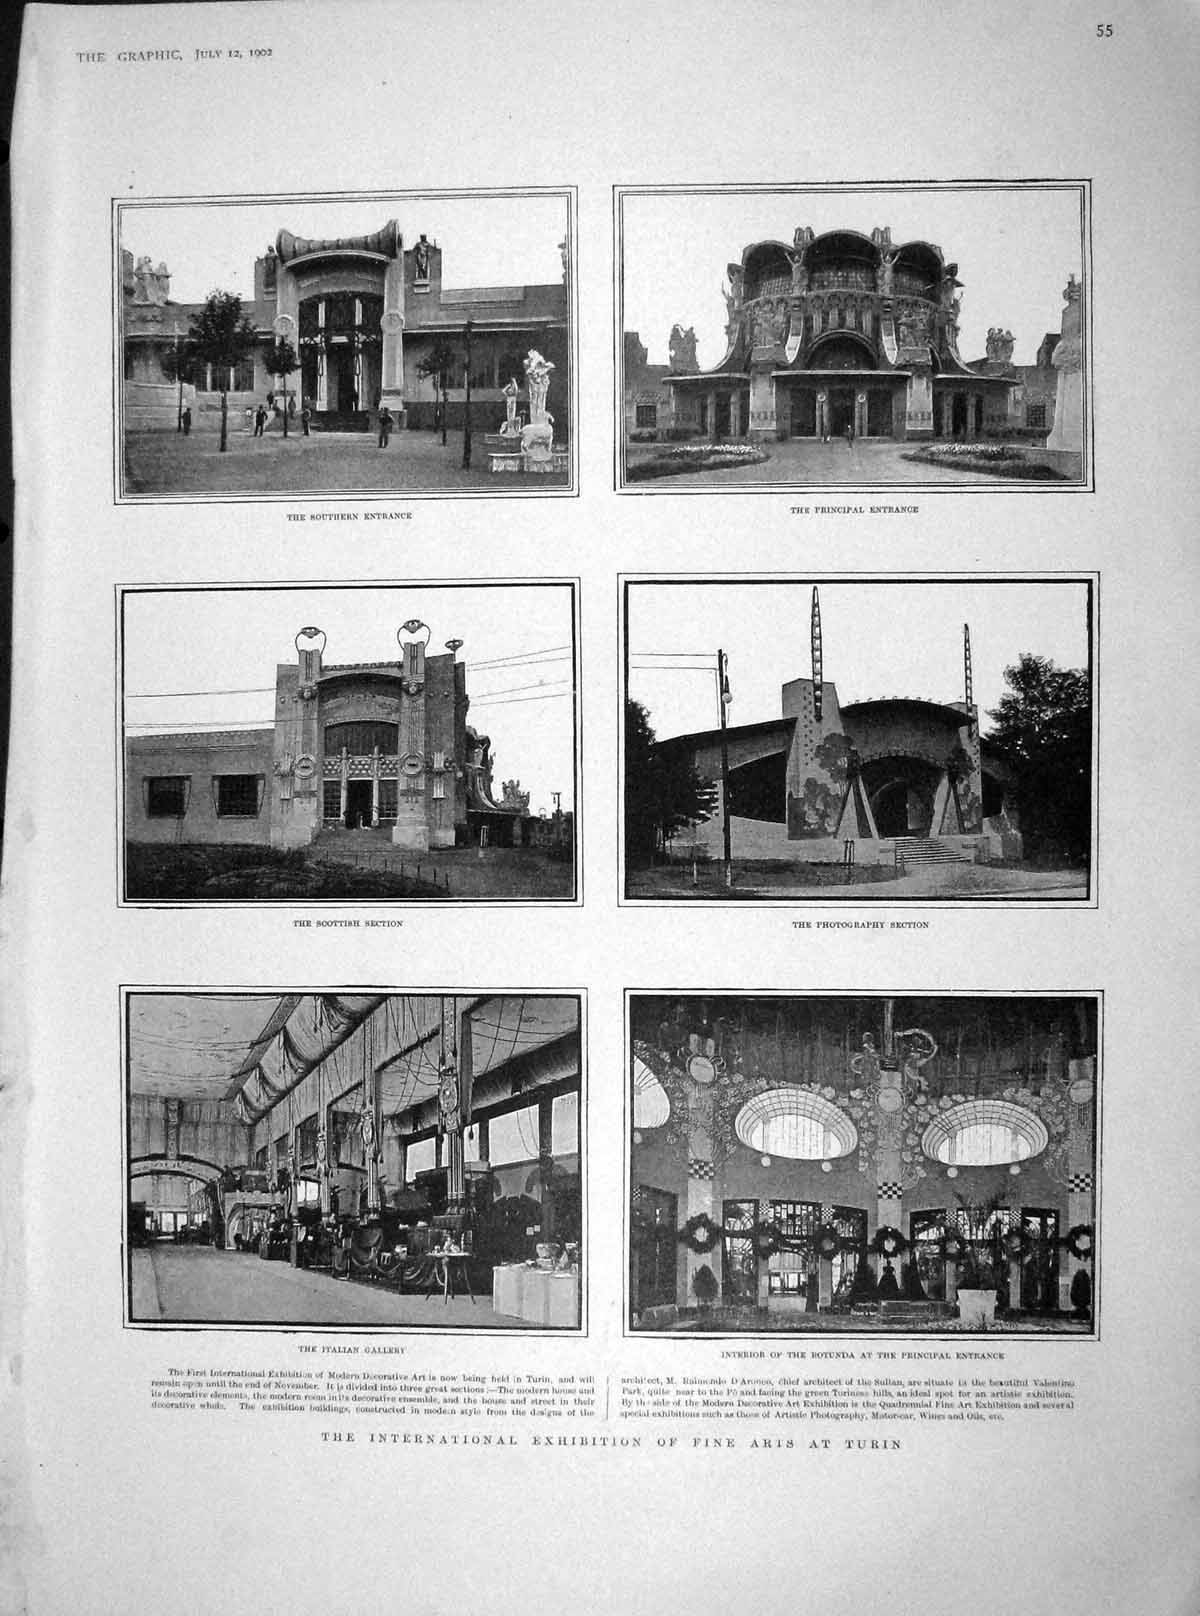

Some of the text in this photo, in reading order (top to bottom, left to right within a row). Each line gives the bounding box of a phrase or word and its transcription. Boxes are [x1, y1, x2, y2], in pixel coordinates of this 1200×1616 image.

[1096, 24, 1112, 37] 55
[76, 48, 272, 63] THE GRAPHIC, JULY 12, 1902
[815, 506, 864, 514] PRINCIPAL
[870, 506, 919, 514] ENTRANCE
[310, 513, 358, 521] SOUTHERN
[364, 512, 412, 520] ENTRANCE
[364, 1346, 404, 1354] GALLERY
[721, 1351, 765, 1359] INTERIOR
[770, 1351, 782, 1359] OF
[787, 1351, 806, 1359] THE
[860, 1352, 872, 1360] AT
[878, 1352, 896, 1360] THE
[902, 1352, 950, 1360] PRINCIPAL
[956, 1352, 1005, 1360] ENTRANCE
[168, 1368, 183, 1377] The
[188, 1368, 206, 1377] First
[210, 1368, 264, 1378] International
[269, 1369, 312, 1378] Exhibition
[329, 1371, 359, 1380] Modern
[412, 1372, 426, 1381] Art
[429, 1372, 436, 1381] is
[463, 1373, 486, 1384] being
[492, 1373, 509, 1382] held
[514, 1374, 521, 1382] in
[526, 1374, 552, 1384] Turin,
[559, 1374, 574, 1383] and
[580, 1375, 595, 1383] will
[804, 1377, 842, 1385] architect
[845, 1377, 853, 1386] of
[858, 1377, 871, 1386] the
[874, 1377, 904, 1387] Sultan,
[972, 1378, 986, 1386] the
[206, 1379, 226, 1388] until
[229, 1380, 242, 1388] the
[245, 1380, 260, 1389] end
[263, 1380, 271, 1389] of
[275, 1381, 320, 1390] November.
[327, 1382, 334, 1390] It
[337, 1382, 343, 1390] is
[346, 1382, 377, 1391] divided
[380, 1383, 397, 1392] into
[400, 1383, 422, 1392] three
[426, 1383, 447, 1394] great
[516, 1385, 549, 1394] modern
[152, 1389, 160, 1398] its
[164, 1389, 207, 1399] decorative
[253, 1391, 266, 1399] the
[270, 1391, 301, 1400] modern
[328, 1393, 336, 1401] in
[352, 1394, 396, 1403] decorative
[443, 1395, 458, 1404] and
[464, 1395, 477, 1404] the
[511, 1396, 526, 1404] and
[531, 1396, 555, 1405] street
[561, 1396, 568, 1405] in
[574, 1396, 595, 1405] their
[698, 1387, 706, 1396] to
[710, 1387, 723, 1396] the
[740, 1387, 756, 1396] and
[788, 1388, 801, 1396] the
[805, 1390, 828, 1398] green
[910, 1389, 930, 1397] ideal
[935, 1389, 953, 1399] spot
[958, 1389, 970, 1398] for
[991, 1389, 1022, 1398] artistic
[1026, 1389, 1073, 1398] exhibition.
[152, 1400, 195, 1409] decorative
[240, 1401, 255, 1410] The
[262, 1402, 304, 1411] exhibition
[356, 1405, 406, 1414] constructed
[411, 1406, 419, 1414] in
[460, 1406, 481, 1417] style
[487, 1407, 507, 1415] from
[512, 1407, 526, 1416] the
[568, 1408, 576, 1416] of
[580, 1408, 595, 1416] the
[622, 1398, 633, 1408] By
[672, 1398, 681, 1406] of
[686, 1398, 699, 1406] the
[702, 1398, 733, 1407] Modern
[787, 1399, 800, 1407] Art
[804, 1399, 848, 1408] Exhibition
[851, 1400, 858, 1408] is
[862, 1400, 876, 1408] the
[935, 1400, 954, 1408] Fine
[958, 1400, 972, 1408] Art
[975, 1400, 1021, 1409] Exhibition
[1024, 1400, 1039, 1409] and
[1042, 1400, 1074, 1409] several
[620, 1408, 649, 1419] special
[652, 1408, 700, 1417] exhibitions
[702, 1409, 722, 1418] such
[762, 1410, 770, 1418] of
[775, 1410, 807, 1418] Artistic
[948, 1411, 963, 1420] and
[321, 1432, 901, 1450] THE INTERNATIONAL EXHIBITION OF FINE ARTS AT TURIN
